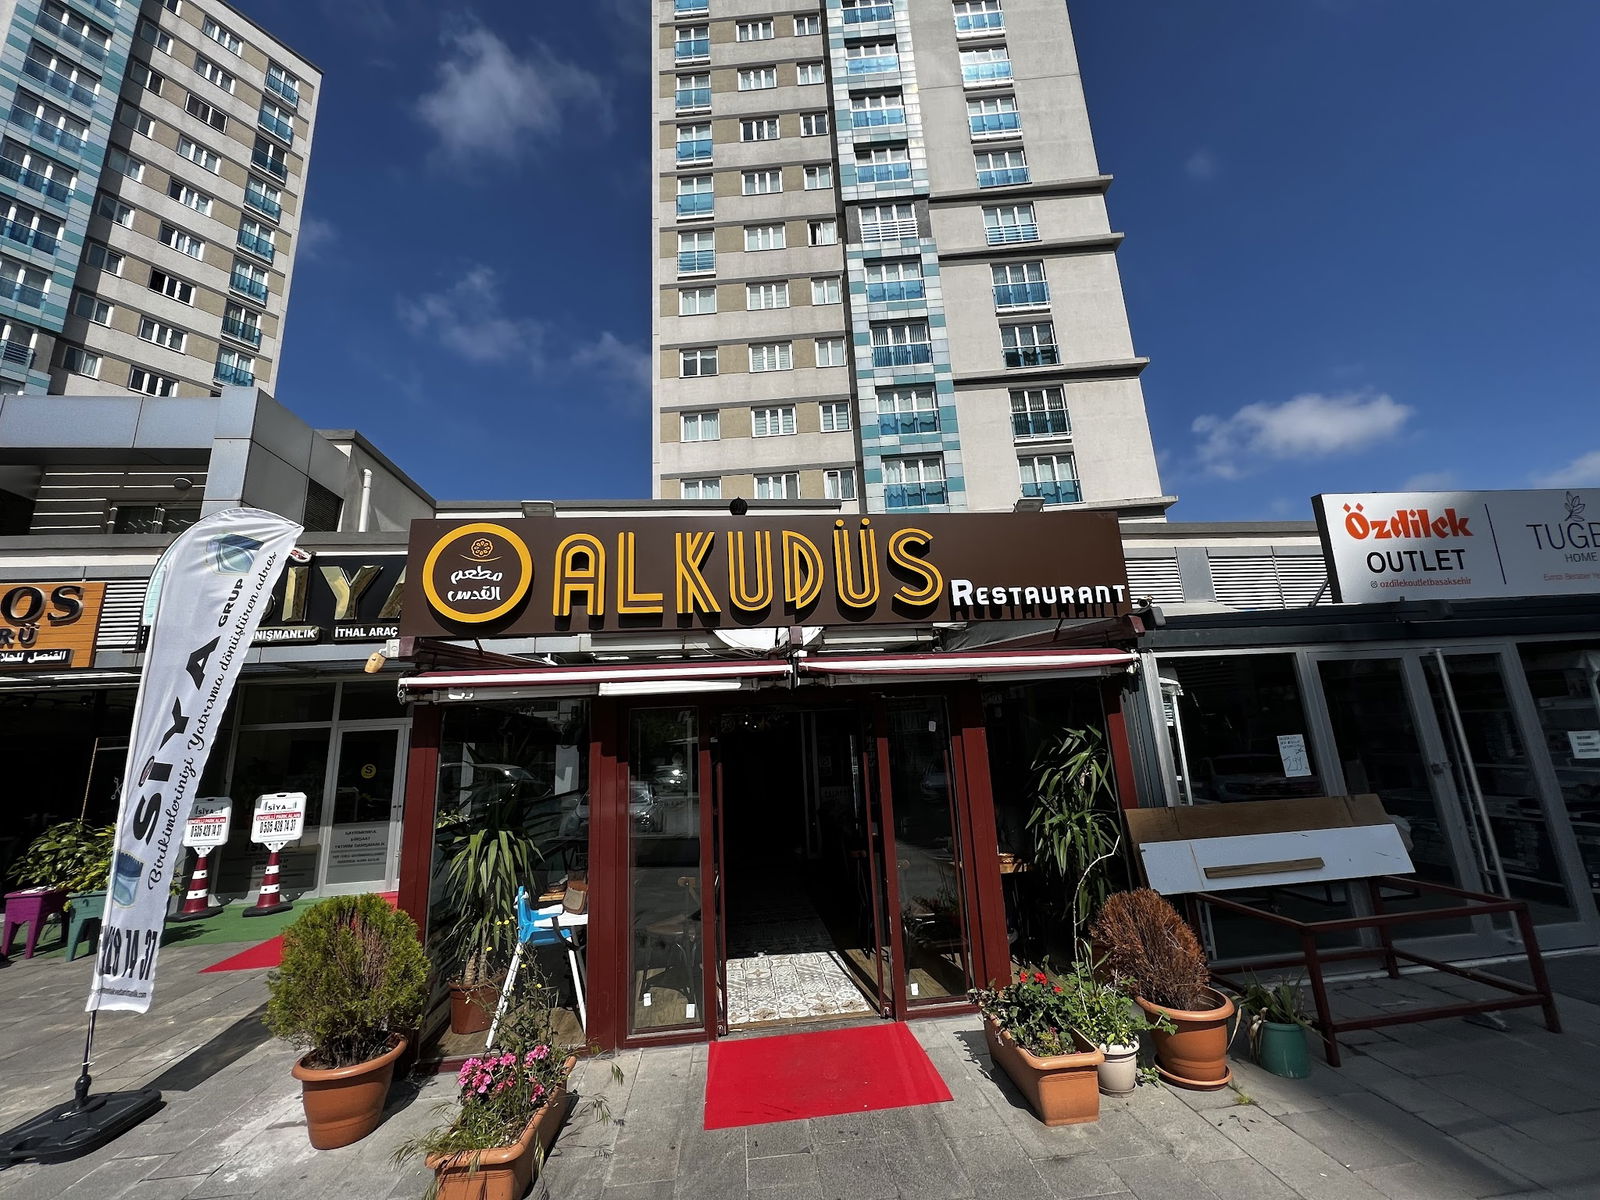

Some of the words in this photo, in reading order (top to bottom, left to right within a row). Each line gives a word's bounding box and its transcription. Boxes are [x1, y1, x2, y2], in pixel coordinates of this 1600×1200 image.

[1343, 503, 1474, 540] Özdilek
[1366, 549, 1466, 574] OUTLET
[1564, 552, 1598, 563] HOME
[253, 551, 278, 600] adres
[450, 565, 503, 584] مطعم
[217, 578, 244, 628] GRUP
[447, 585, 502, 602] القدس
[334, 625, 367, 638] İTHAL
[368, 626, 399, 638] ARAÇ
[121, 929, 139, 978] 74
[139, 929, 158, 981] 37
